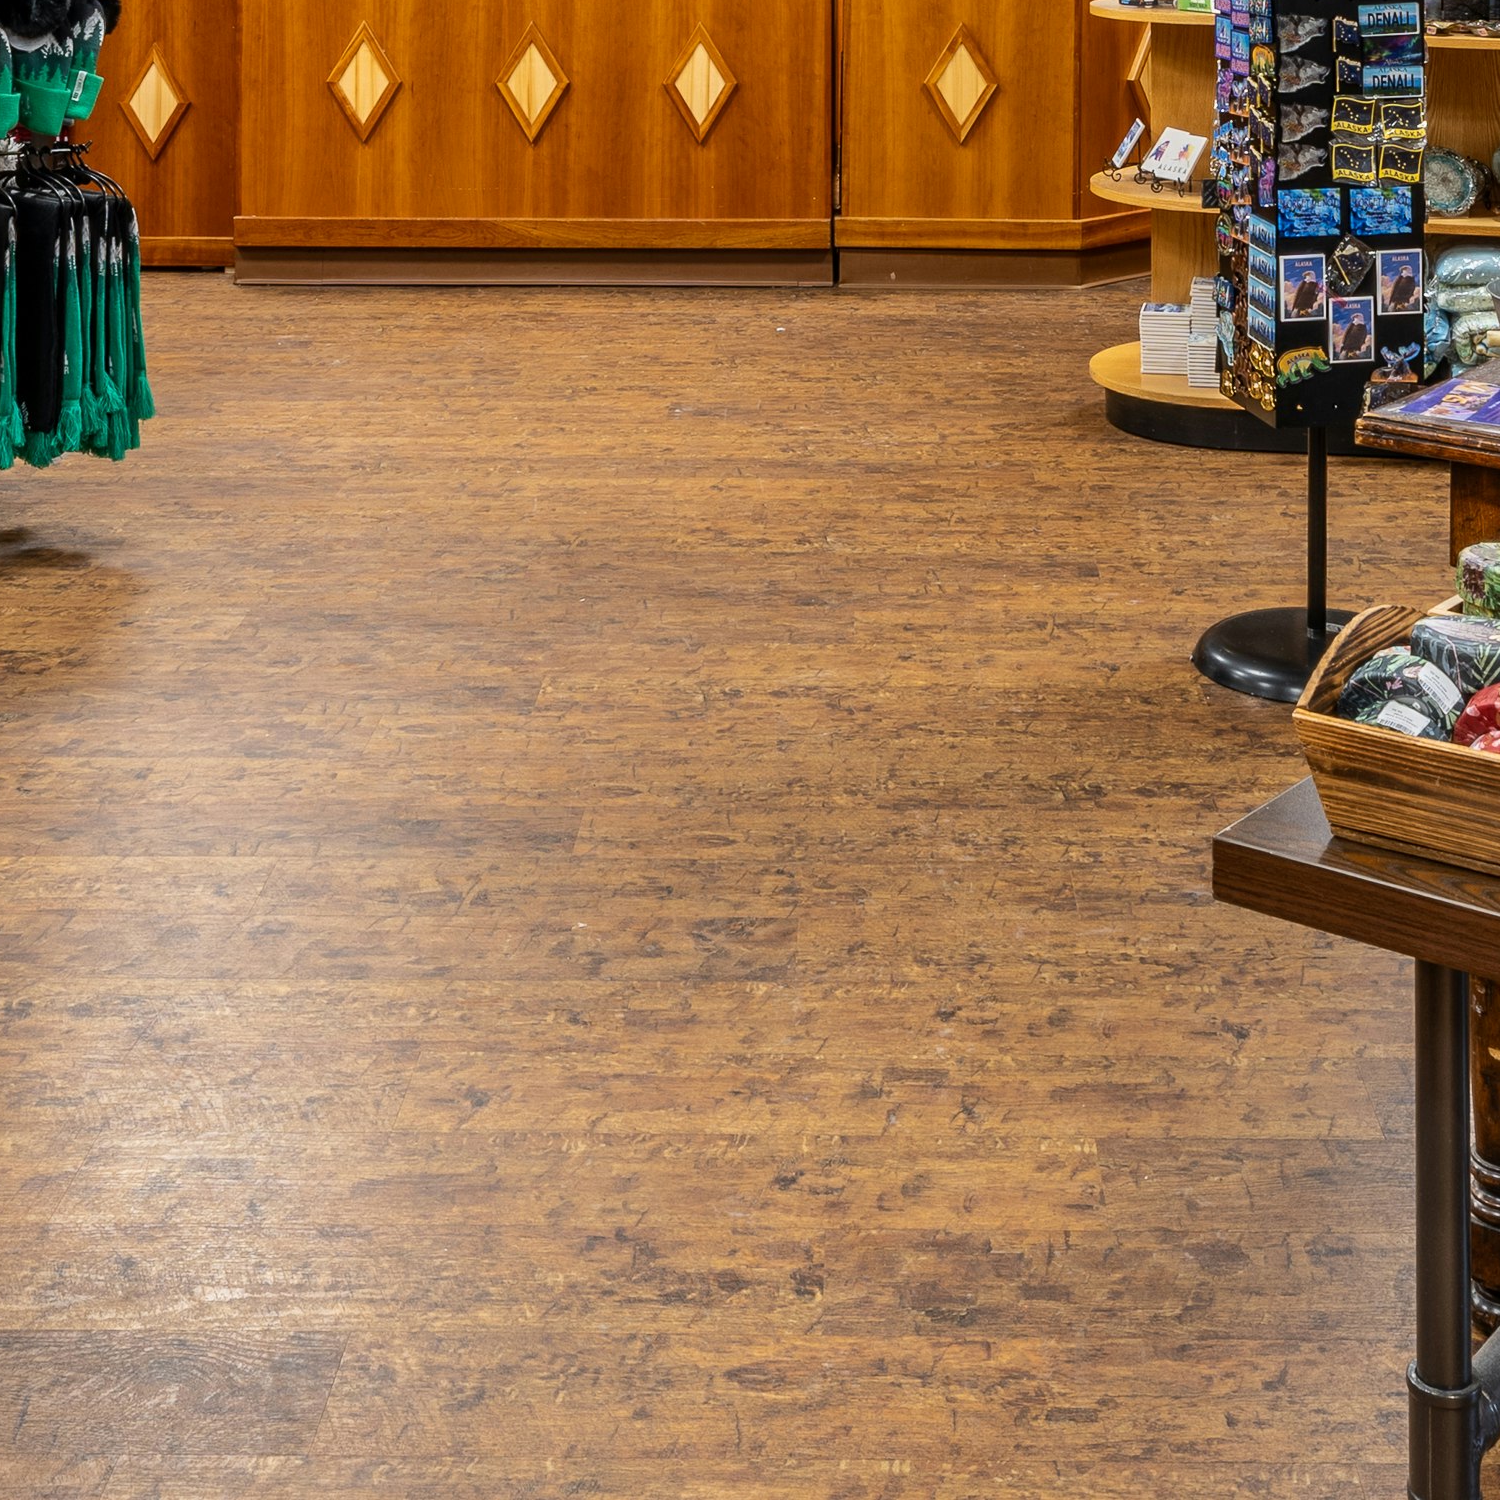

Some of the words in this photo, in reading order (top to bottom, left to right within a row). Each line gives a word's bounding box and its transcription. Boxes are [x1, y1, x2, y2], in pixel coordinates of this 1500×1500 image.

[1368, 10, 1410, 30] DENALI
[1373, 73, 1414, 91] DENALI
[1337, 122, 1370, 134] ALASKA
[1294, 260, 1313, 268] ALASKA
